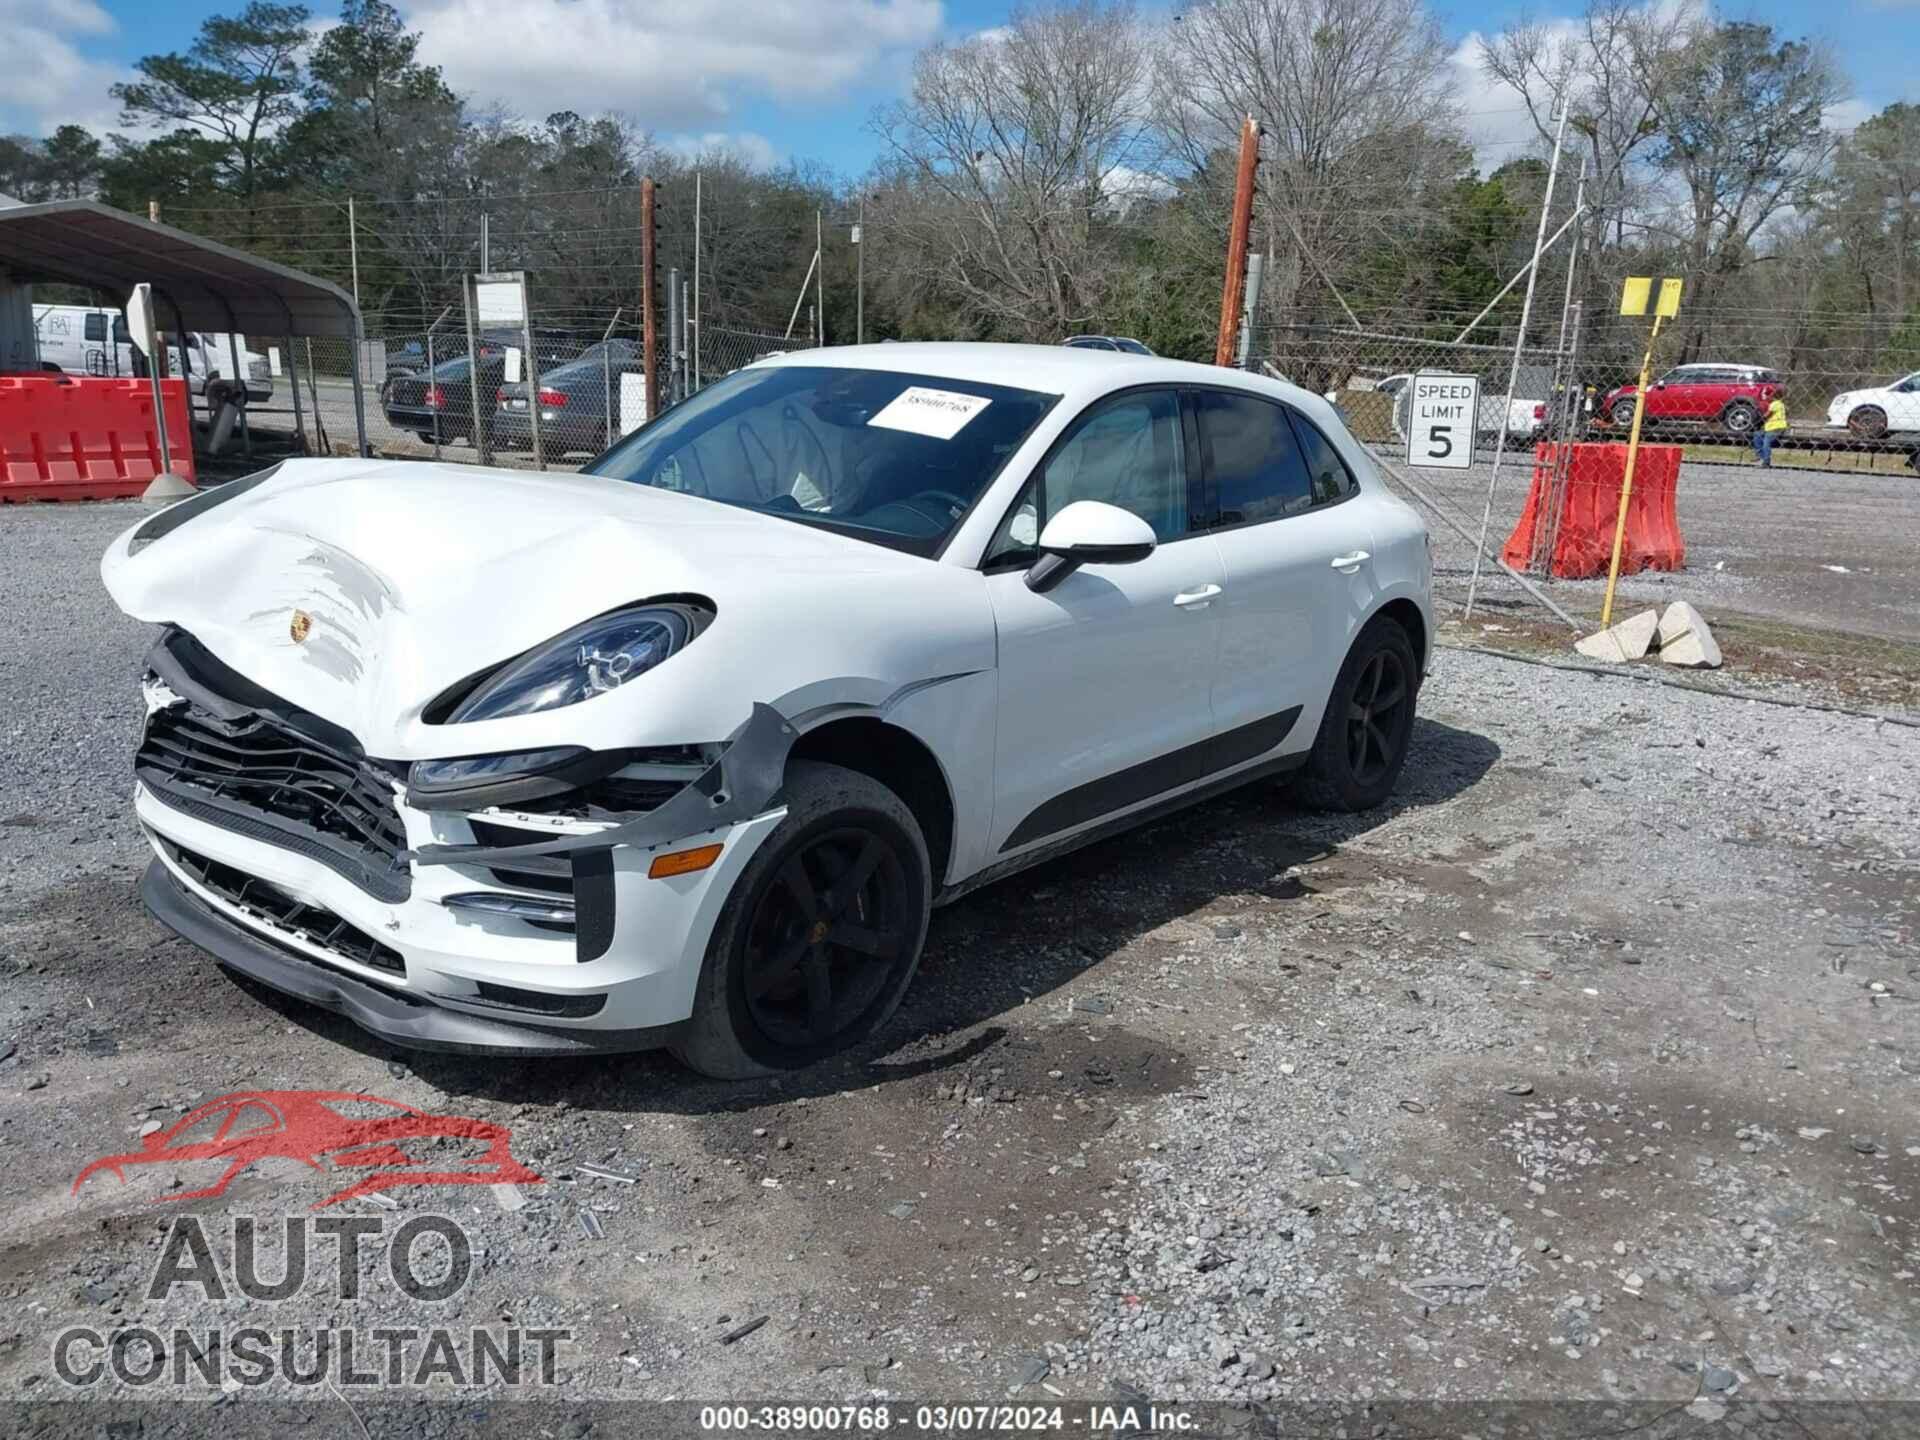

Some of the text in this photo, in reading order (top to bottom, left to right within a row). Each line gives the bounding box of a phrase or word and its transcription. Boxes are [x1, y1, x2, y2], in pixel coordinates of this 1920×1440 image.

[1418, 385, 1472, 399] SPEED
[1421, 405, 1464, 418] LIMIT
[1427, 425, 1453, 459] 5
